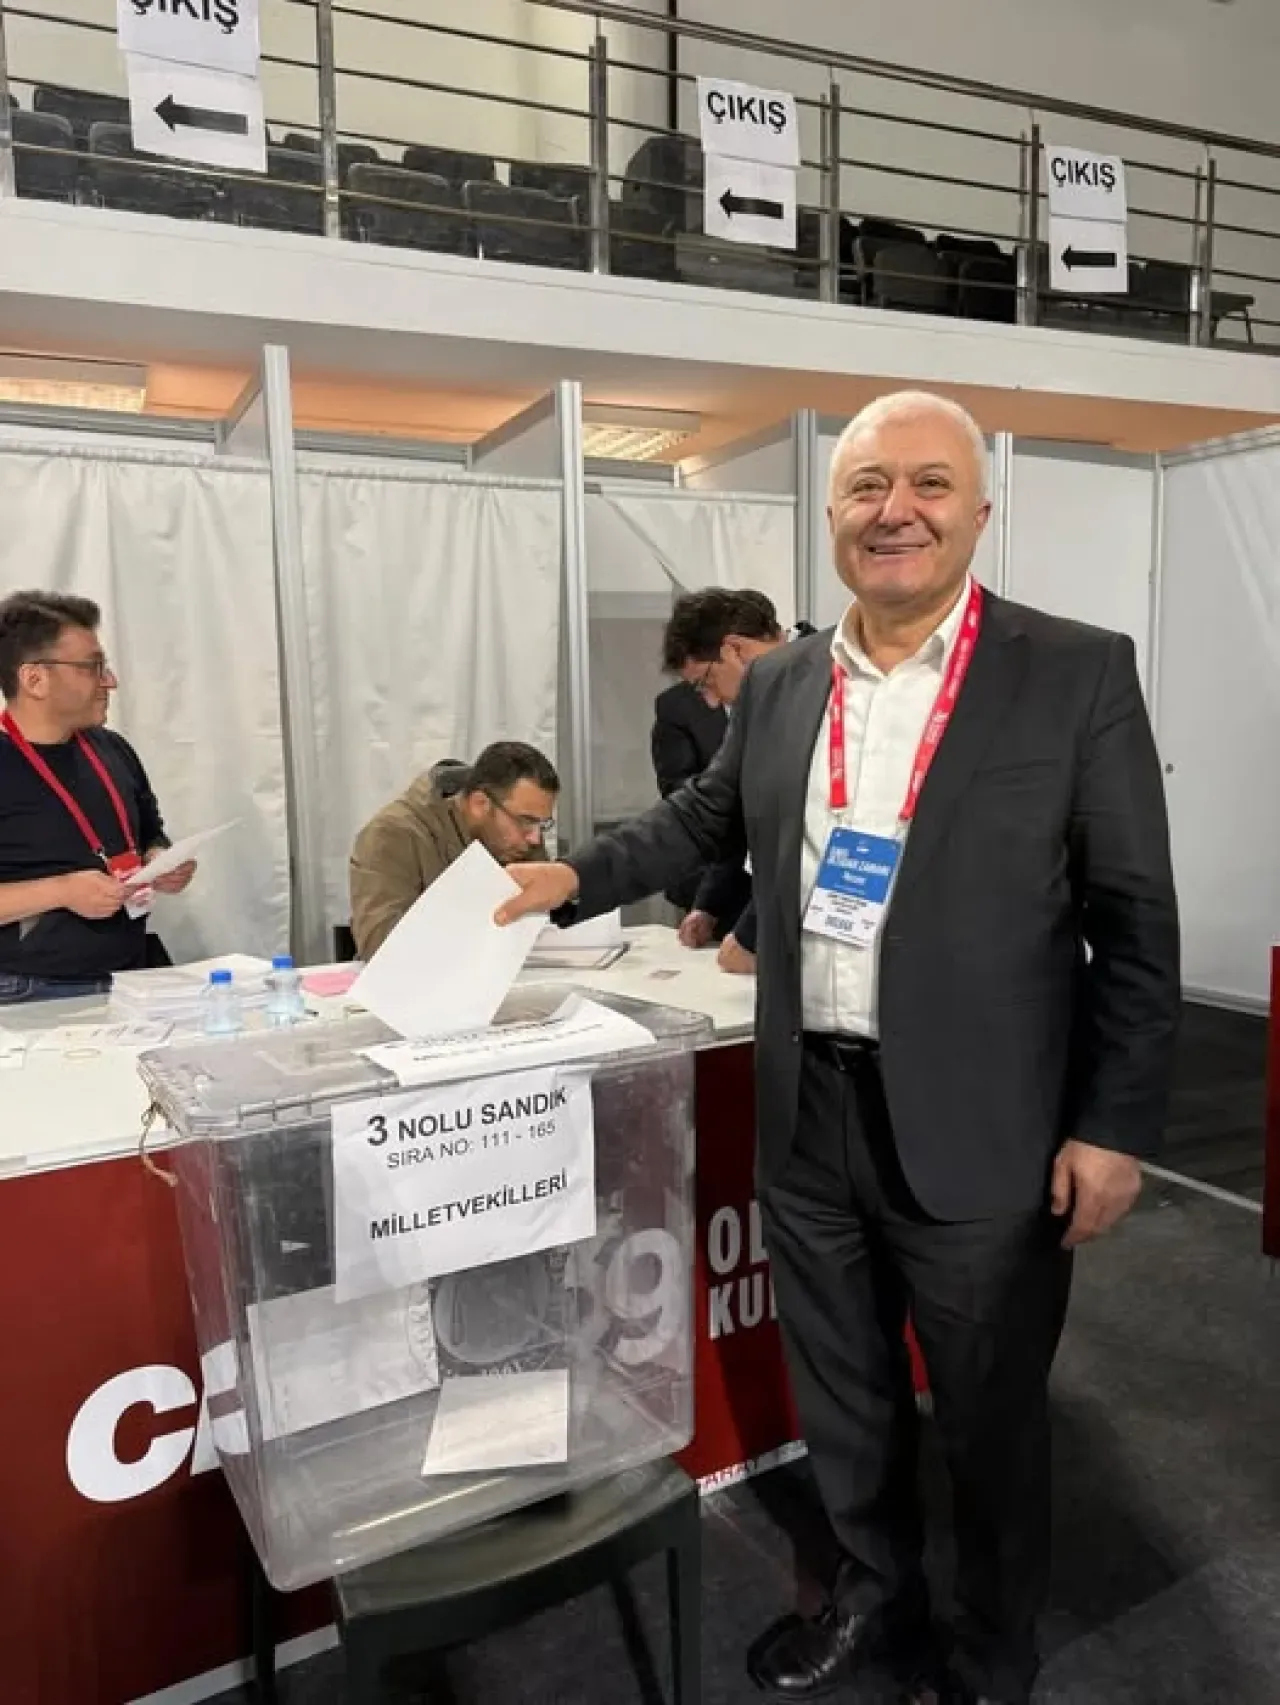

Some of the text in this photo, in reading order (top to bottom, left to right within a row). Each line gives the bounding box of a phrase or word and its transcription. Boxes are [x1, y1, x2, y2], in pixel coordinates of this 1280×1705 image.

[707, 90, 786, 134] ÇIKIŞ
[1051, 157, 1115, 192] ÇIKIŞ
[367, 1085, 568, 1147] 3 NOLU SANDIK
[386, 1144, 434, 1169] SIRA
[439, 1137, 475, 1159] NO:
[482, 1130, 510, 1149] 111
[527, 1118, 557, 1140] 165
[370, 1167, 567, 1239] MİLLETVEKİLLERİ
[707, 1199, 770, 1276] OL
[707, 1272, 778, 1341] KU
